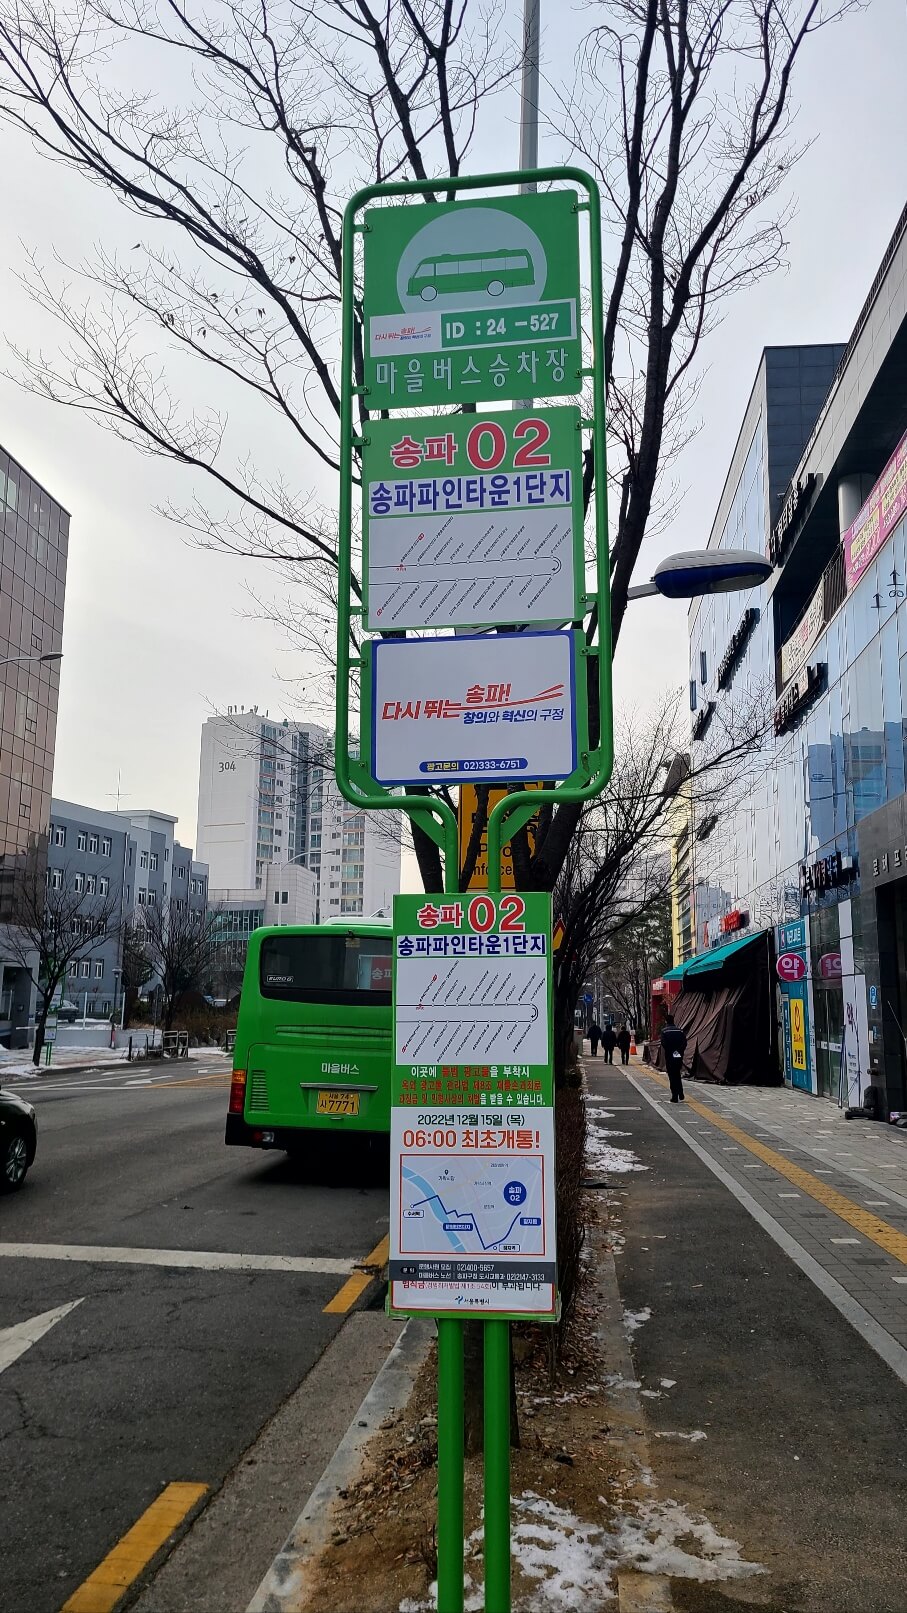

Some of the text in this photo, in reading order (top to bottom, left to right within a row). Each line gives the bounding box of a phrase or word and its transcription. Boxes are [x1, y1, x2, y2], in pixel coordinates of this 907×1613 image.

[445, 322, 465, 339] ID
[376, 348, 569, 395] 마을버스승차장
[390, 418, 551, 471] 송파 02
[370, 470, 571, 515] 송파파인타운1단지
[466, 683, 512, 704] 송파!
[381, 699, 462, 720] 다시 뛰는
[463, 708, 565, 725] 창의와 혁신의 구정
[218, 761, 237, 773] 304
[427, 760, 520, 772] 광고문의 02)333-6751
[417, 895, 526, 934] 송파 02
[398, 935, 546, 957] 송파파인타운1단지
[782, 958, 800, 979] 약
[321, 1063, 360, 1075] 마을버스
[411, 1066, 437, 1078] 이곳에
[503, 1065, 530, 1078] 부착시
[328, 1100, 355, 1113] 7771
[506, 1093, 513, 1106] 수
[516, 1093, 546, 1106] 있습니다.
[417, 1115, 525, 1126] 2022년 12월 15일 (목)
[403, 1130, 540, 1149] 06:00 최초개통!
